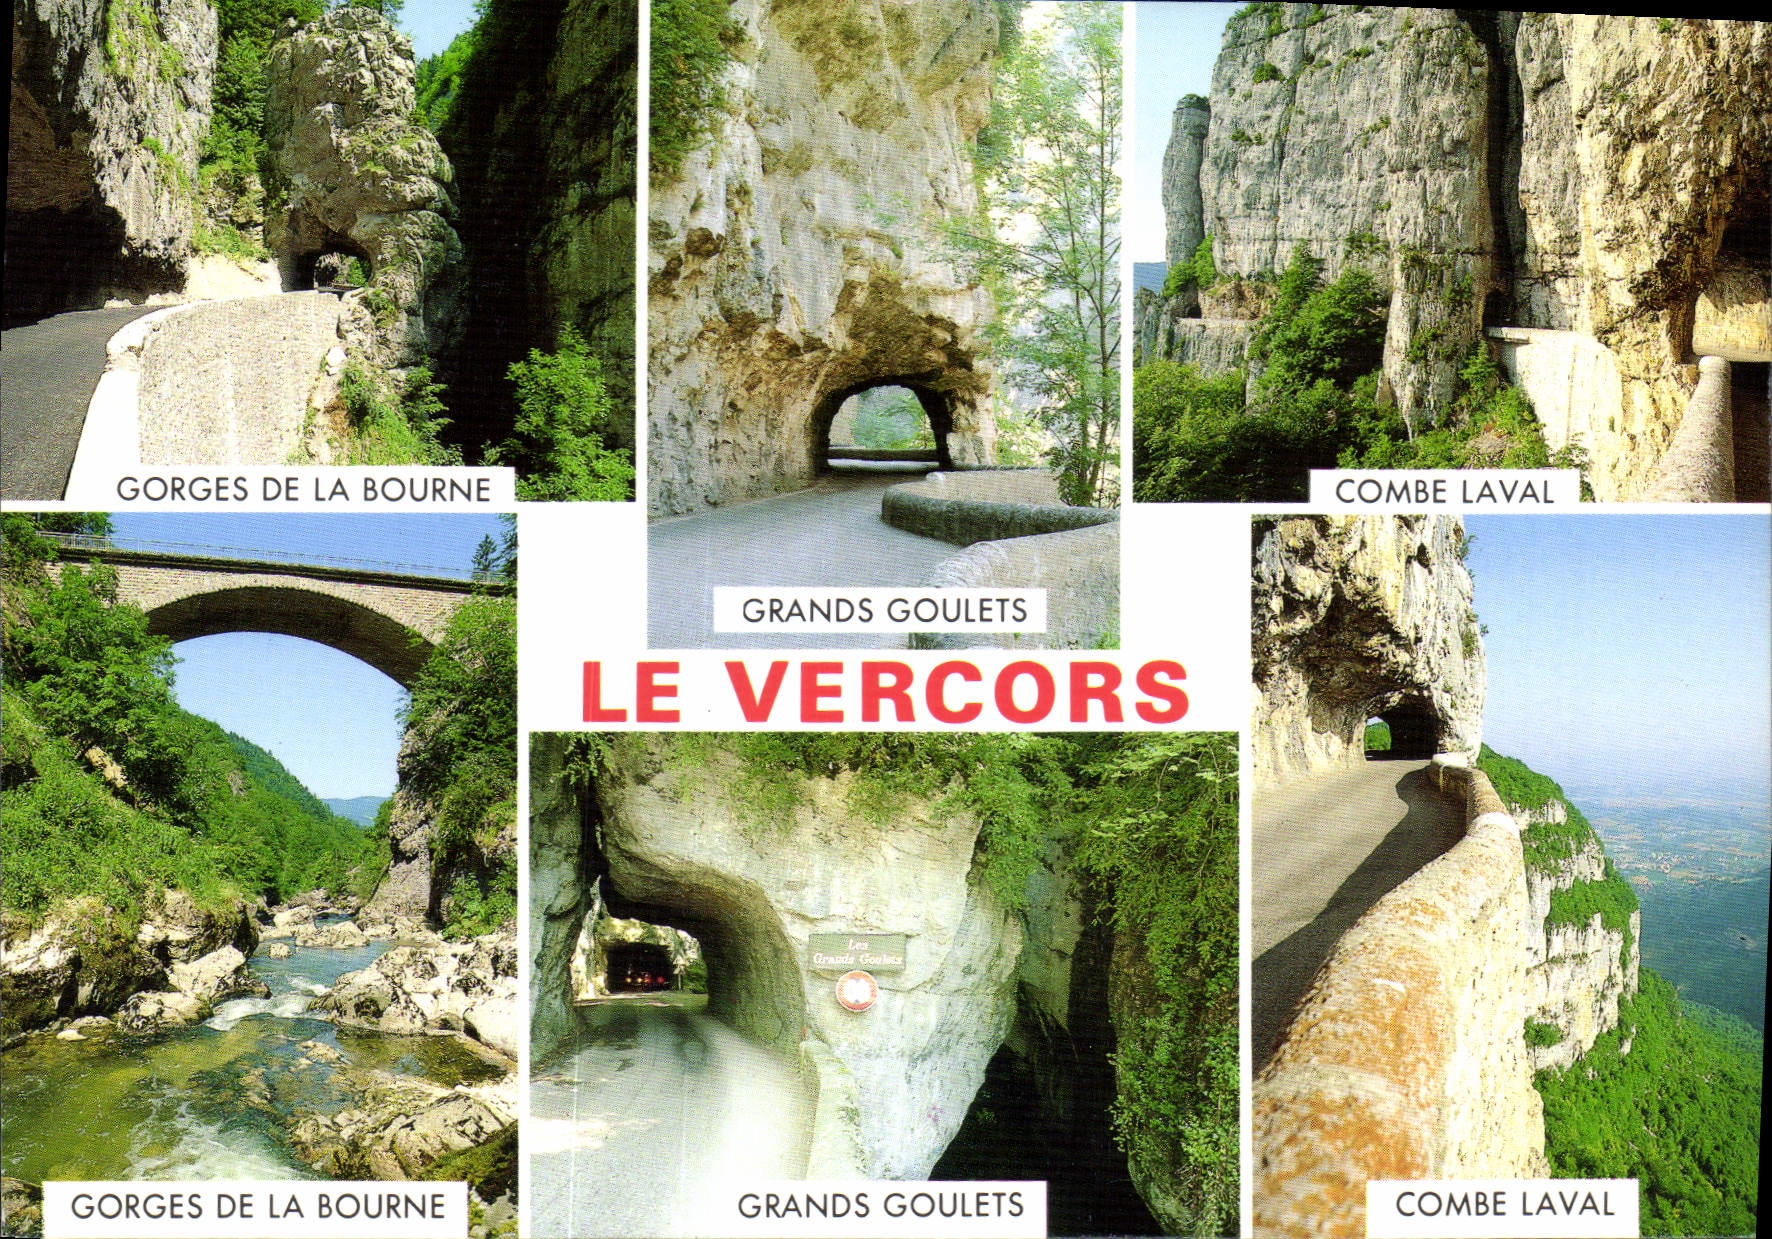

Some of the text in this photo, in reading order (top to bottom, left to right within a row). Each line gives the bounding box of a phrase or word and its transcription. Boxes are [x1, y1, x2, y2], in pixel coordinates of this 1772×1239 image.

[848, 939, 869, 951] Les
[813, 953, 903, 965] Grands Goulets
